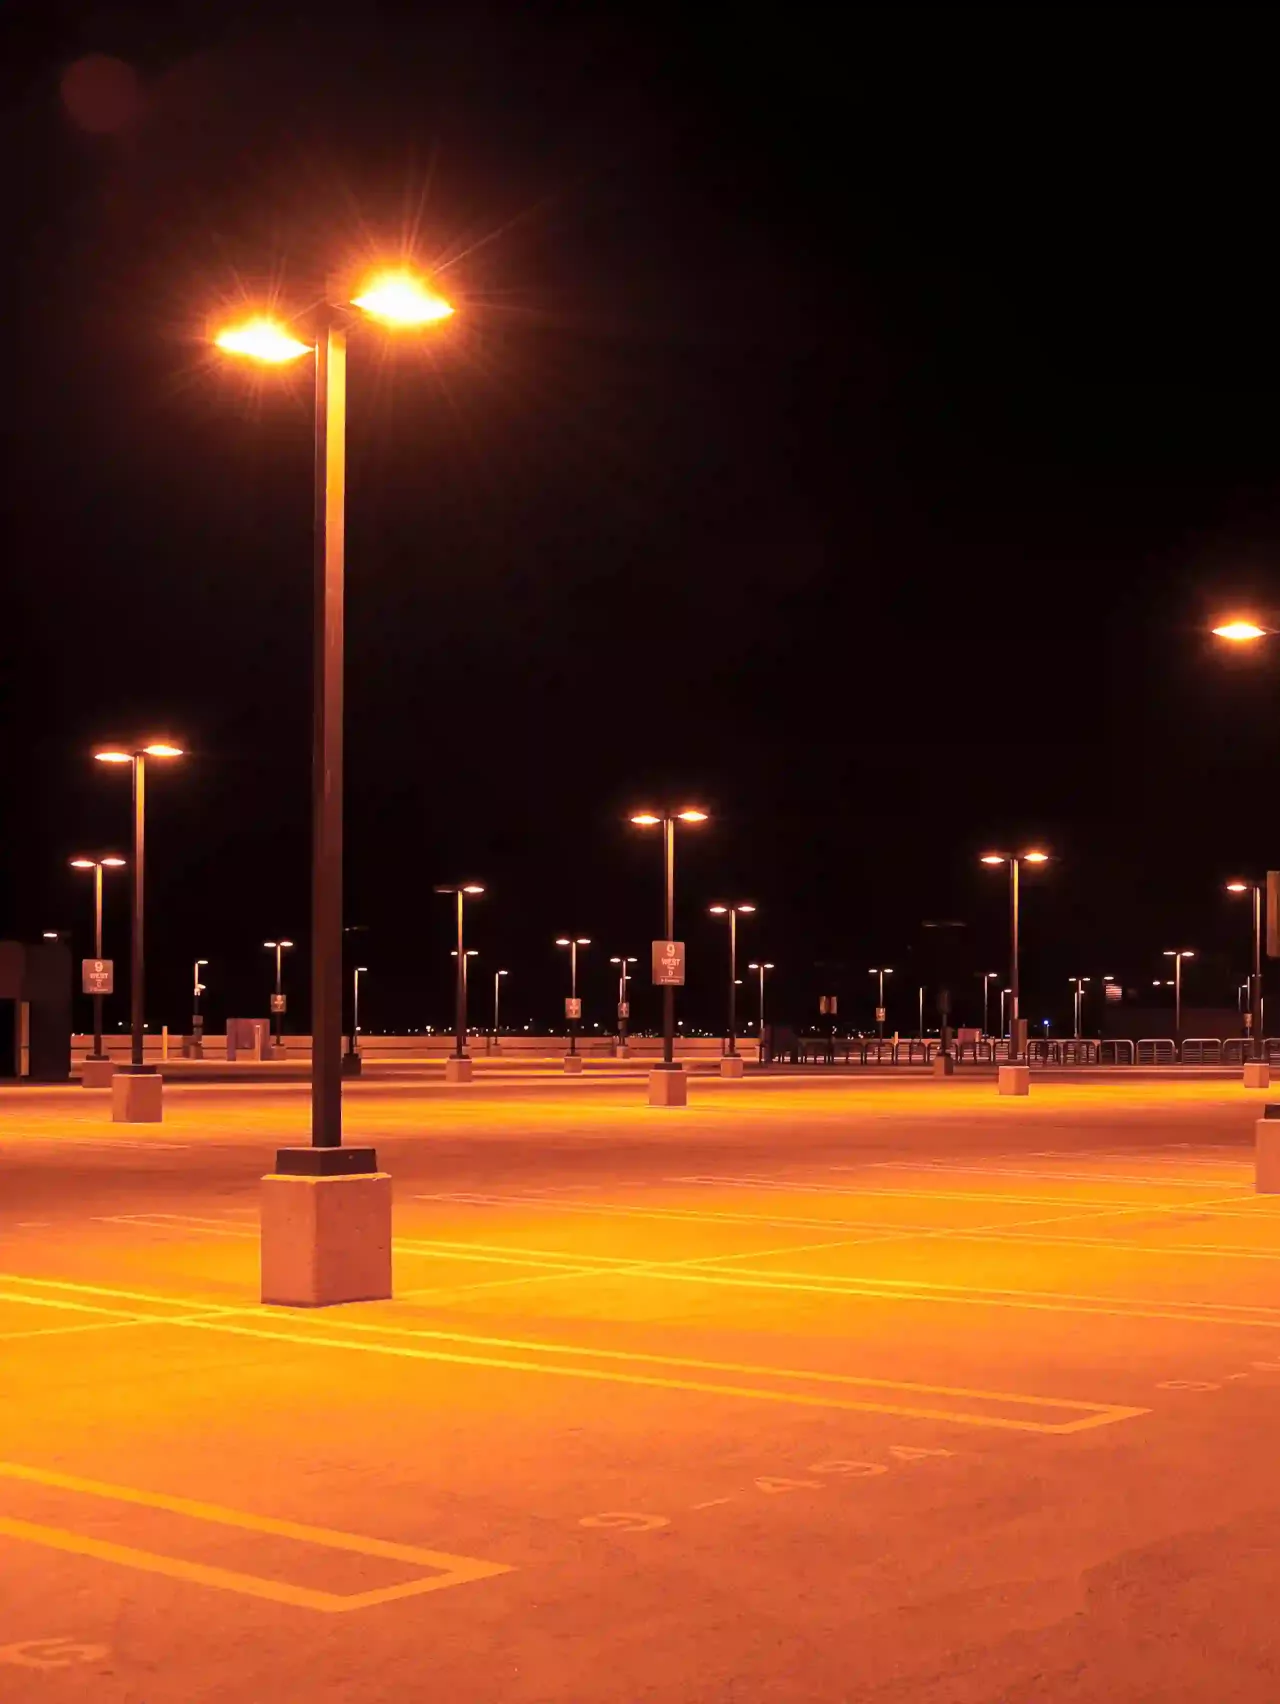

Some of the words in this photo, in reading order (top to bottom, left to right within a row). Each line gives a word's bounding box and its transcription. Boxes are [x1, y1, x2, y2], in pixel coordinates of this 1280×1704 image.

[667, 943, 675, 957] 9
[95, 961, 103, 972] 9
[661, 957, 681, 966] WEST
